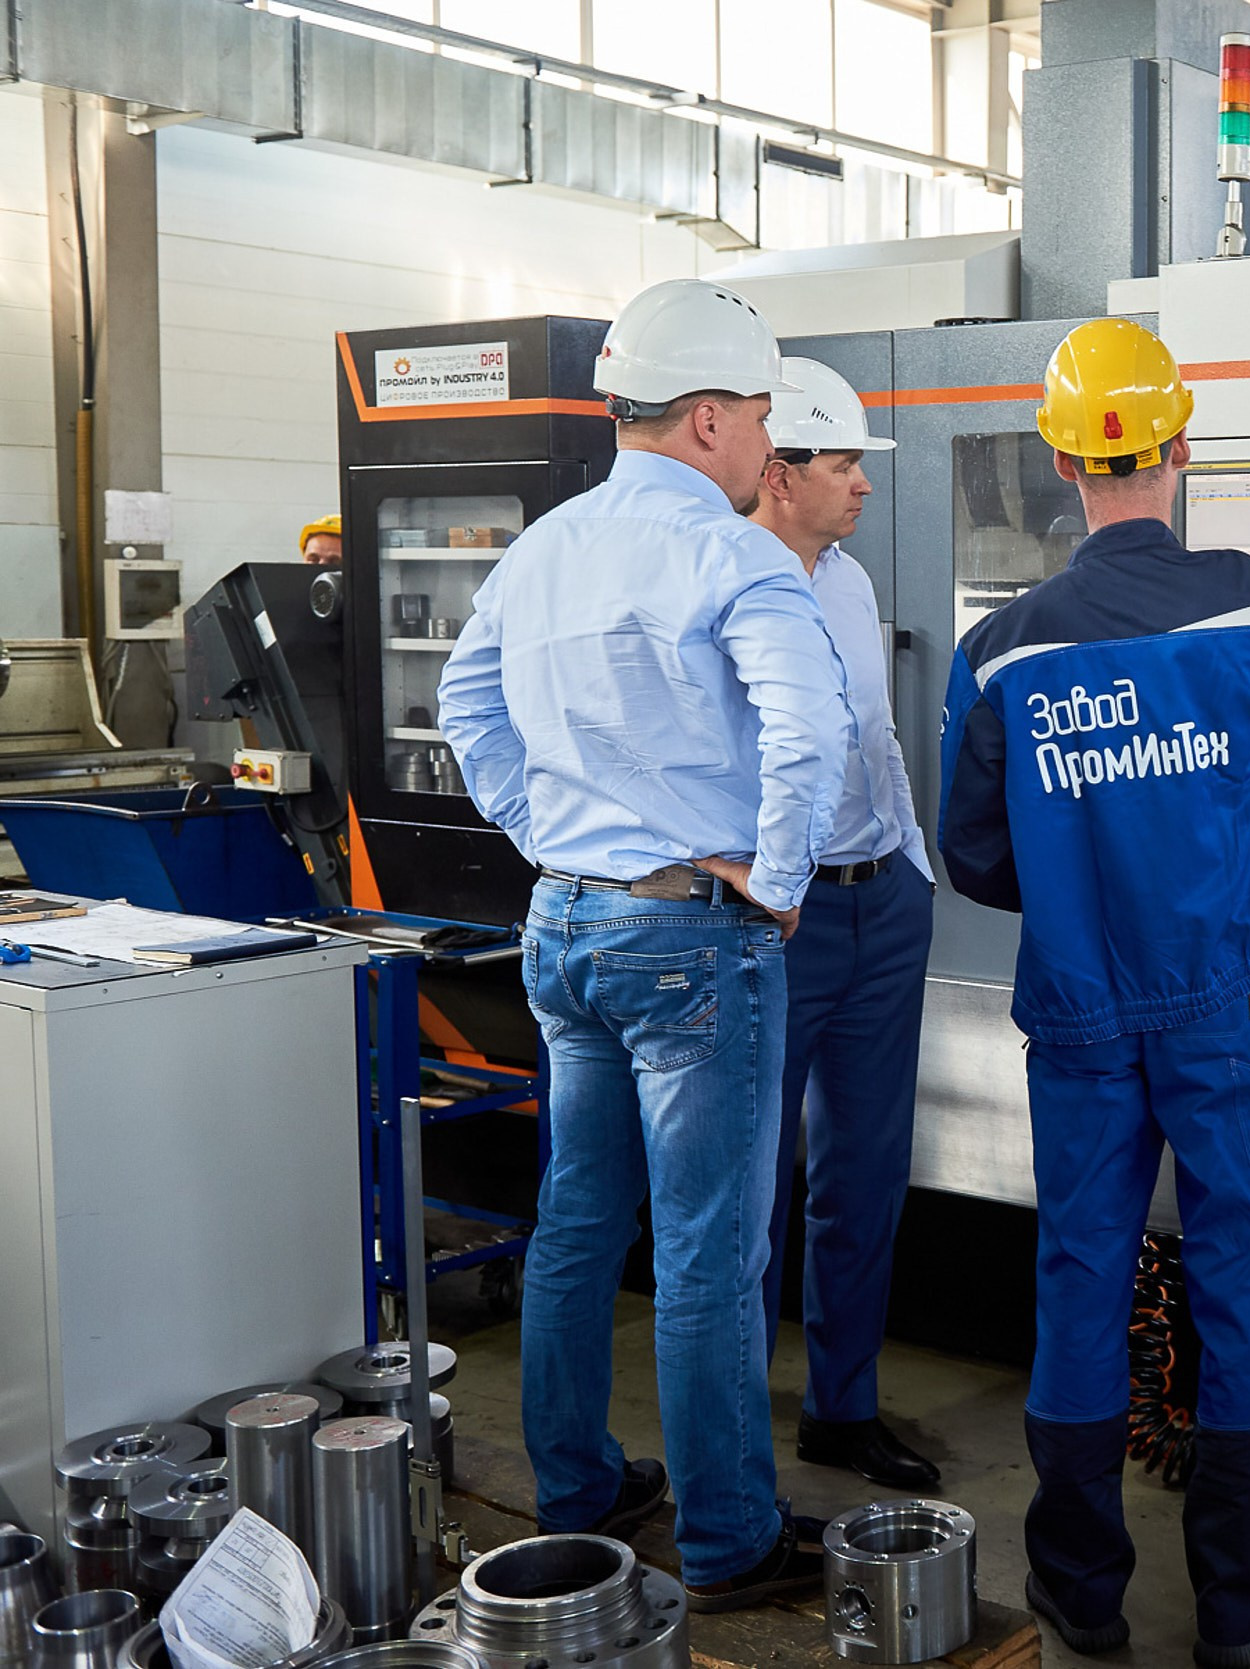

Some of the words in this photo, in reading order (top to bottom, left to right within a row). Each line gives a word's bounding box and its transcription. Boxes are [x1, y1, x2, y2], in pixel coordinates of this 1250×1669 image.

[430, 376, 441, 387] by
[443, 372, 489, 385] INDUSTRY
[489, 371, 505, 382] 4.0
[1027, 678, 1140, 740] Завод
